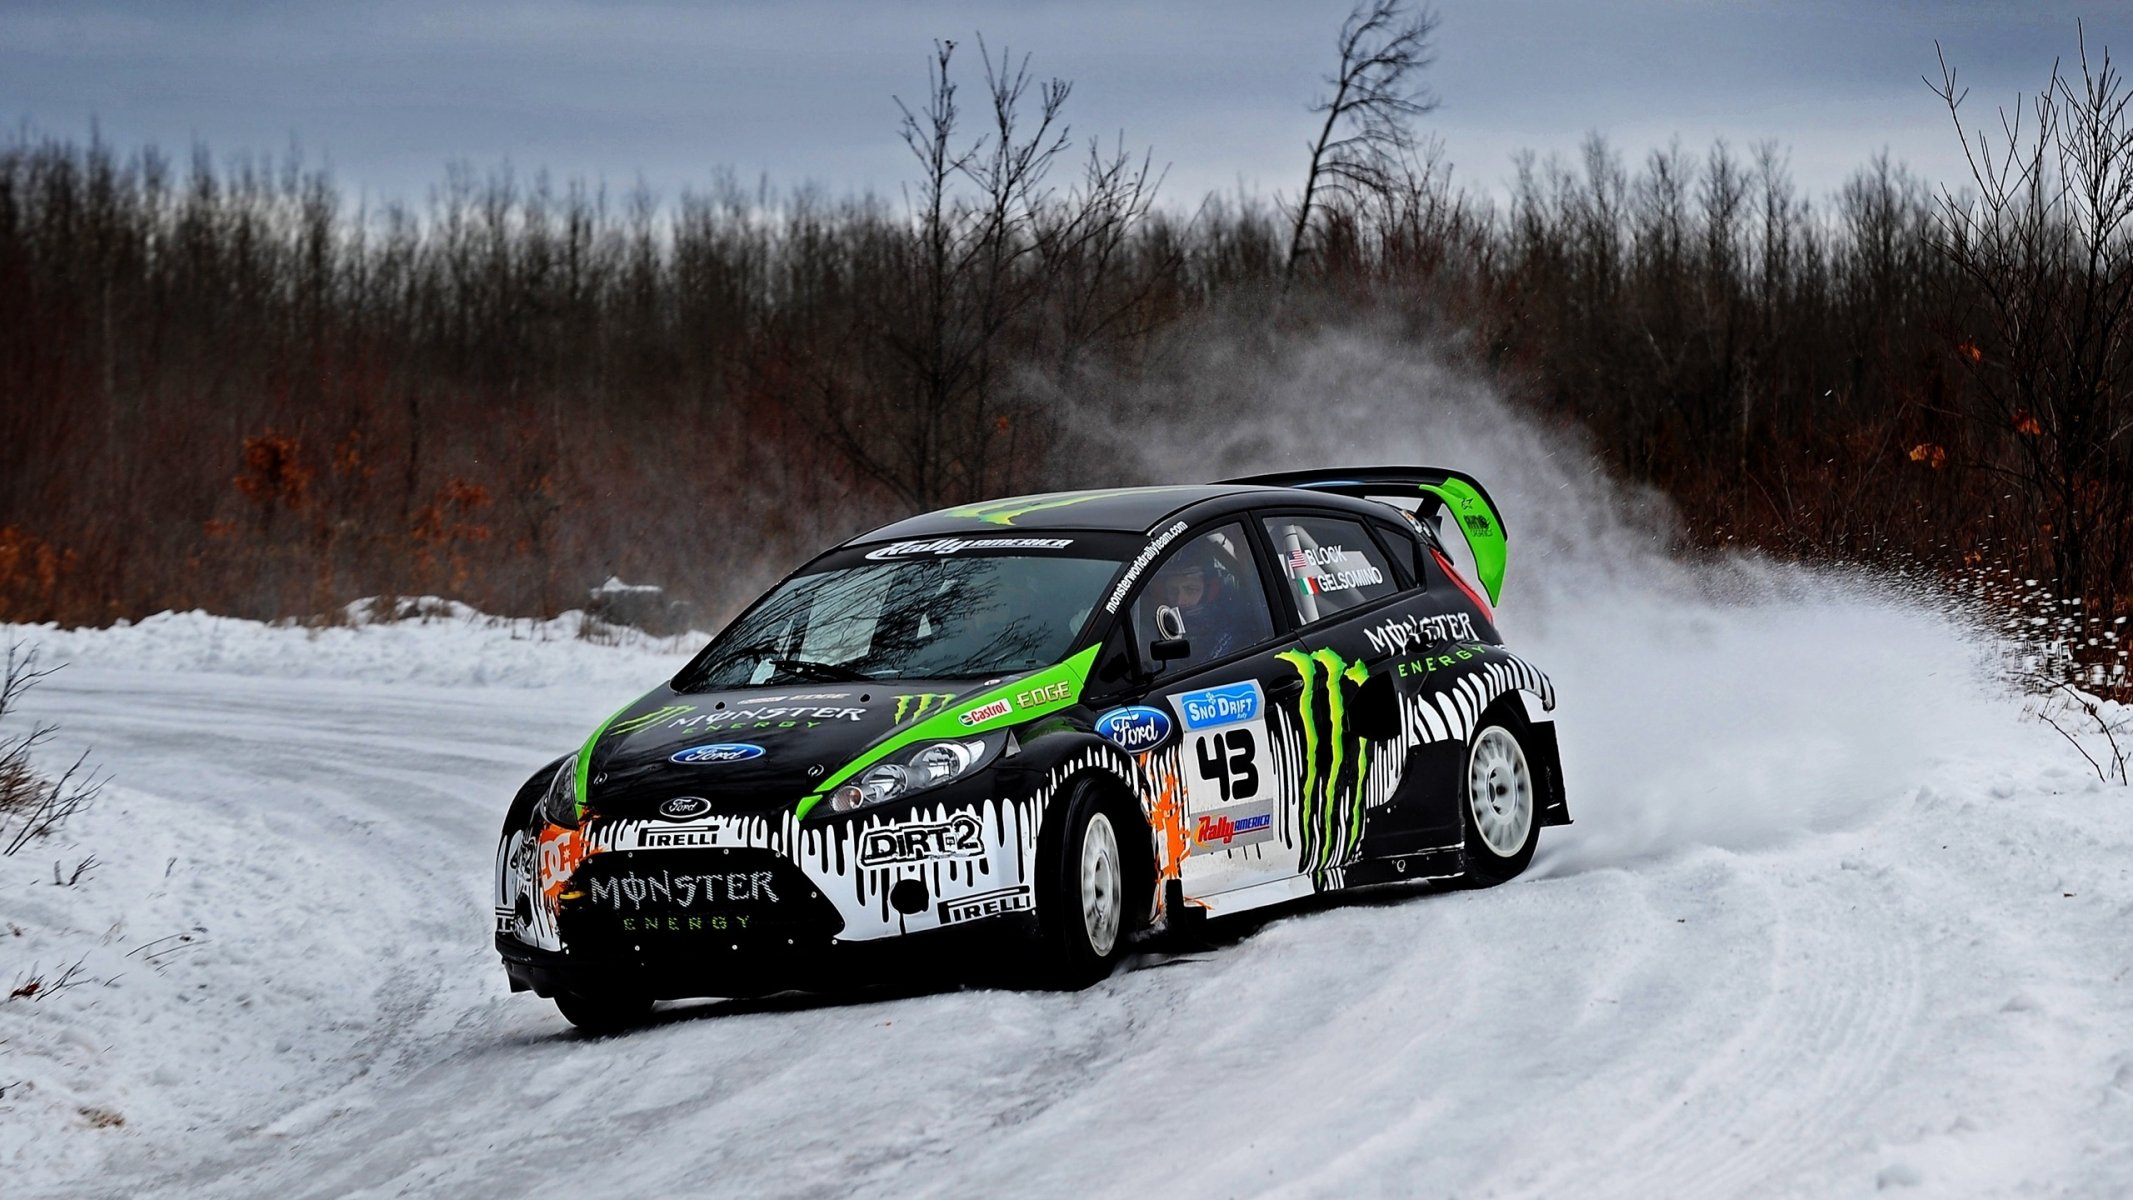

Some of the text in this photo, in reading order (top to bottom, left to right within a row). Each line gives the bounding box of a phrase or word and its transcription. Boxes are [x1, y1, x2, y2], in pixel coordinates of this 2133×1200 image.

[1106, 520, 1188, 614] monsterworldrallyteam.com
[1304, 545, 1346, 567] BLOCK
[1317, 566, 1383, 592] GELSOMINO
[1398, 646, 1485, 677] ENERGY
[970, 680, 1071, 722] Castrol EDGE
[682, 721, 820, 734] ENERGY
[1110, 714, 1158, 747] Ford
[685, 747, 748, 761] Ford
[1196, 728, 1259, 802] 43
[669, 799, 698, 813] Ford
[637, 825, 720, 847] PIRELLI
[1196, 813, 1271, 845] Rally AMERICA
[540, 831, 573, 891] DC
[937, 885, 1030, 925] PIRELLI
[624, 915, 749, 930] ENERGY
